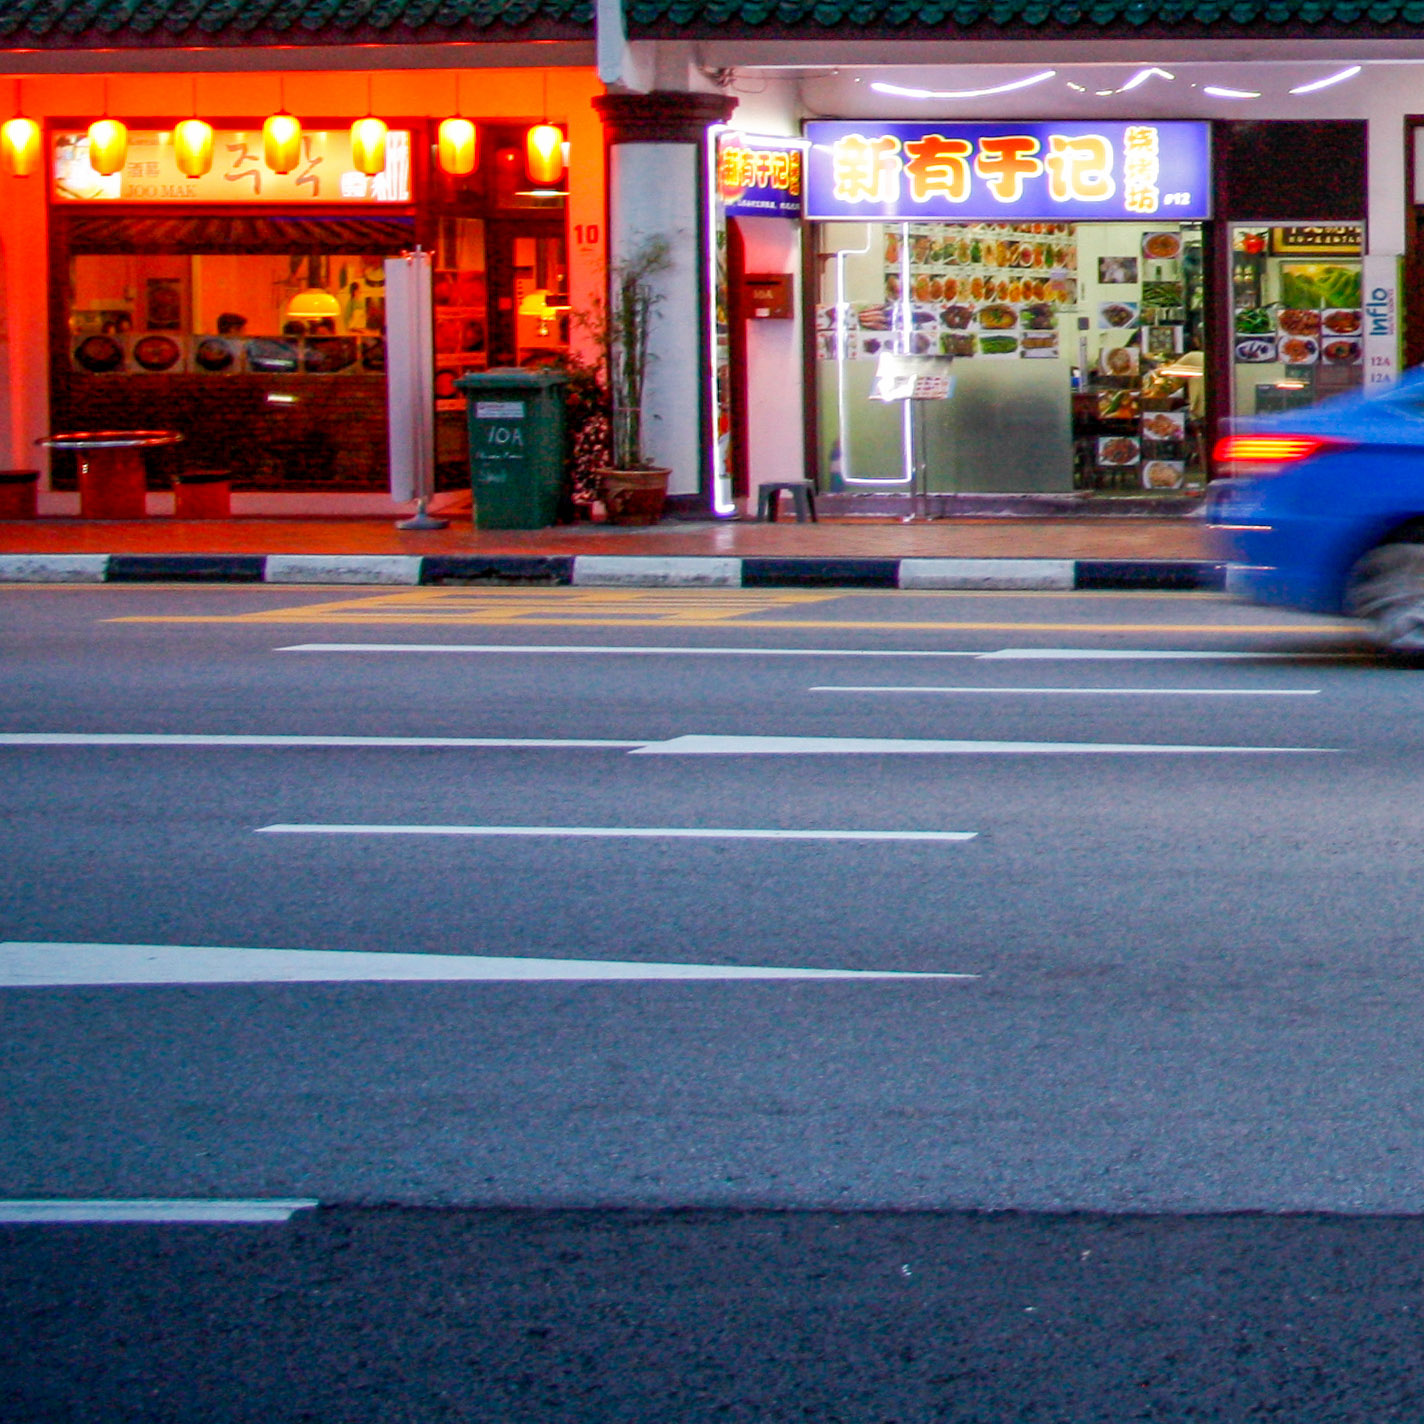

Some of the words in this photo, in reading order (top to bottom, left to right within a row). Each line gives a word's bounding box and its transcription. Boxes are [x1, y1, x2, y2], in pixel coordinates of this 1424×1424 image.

[573, 224, 600, 245] 10
[1371, 356, 1391, 367] 12A
[1370, 373, 1391, 383] 12A
[487, 425, 525, 447] 10A
